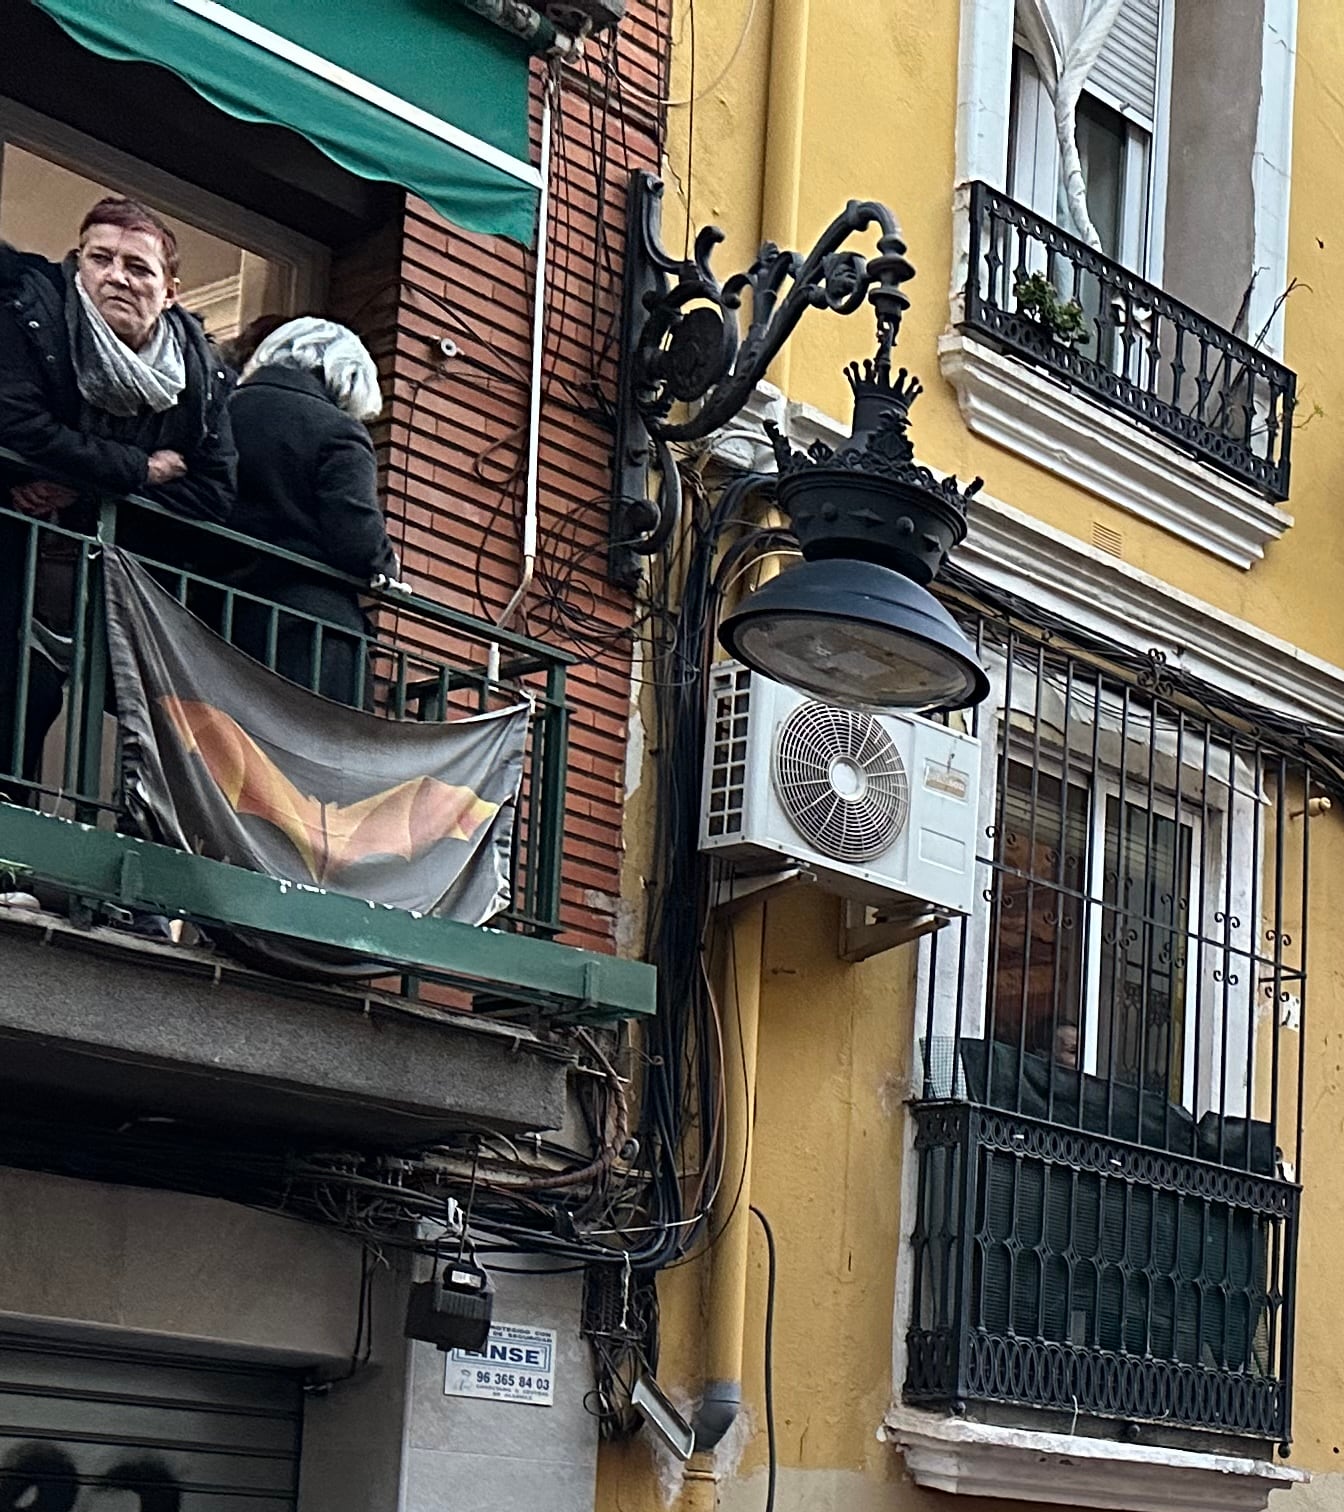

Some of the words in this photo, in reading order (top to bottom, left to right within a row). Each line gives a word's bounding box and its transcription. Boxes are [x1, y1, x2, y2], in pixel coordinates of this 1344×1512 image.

[476, 1370, 491, 1383] 96
[494, 1373, 515, 1386] 365
[518, 1376, 532, 1388] 84
[536, 1379, 550, 1391] 03
